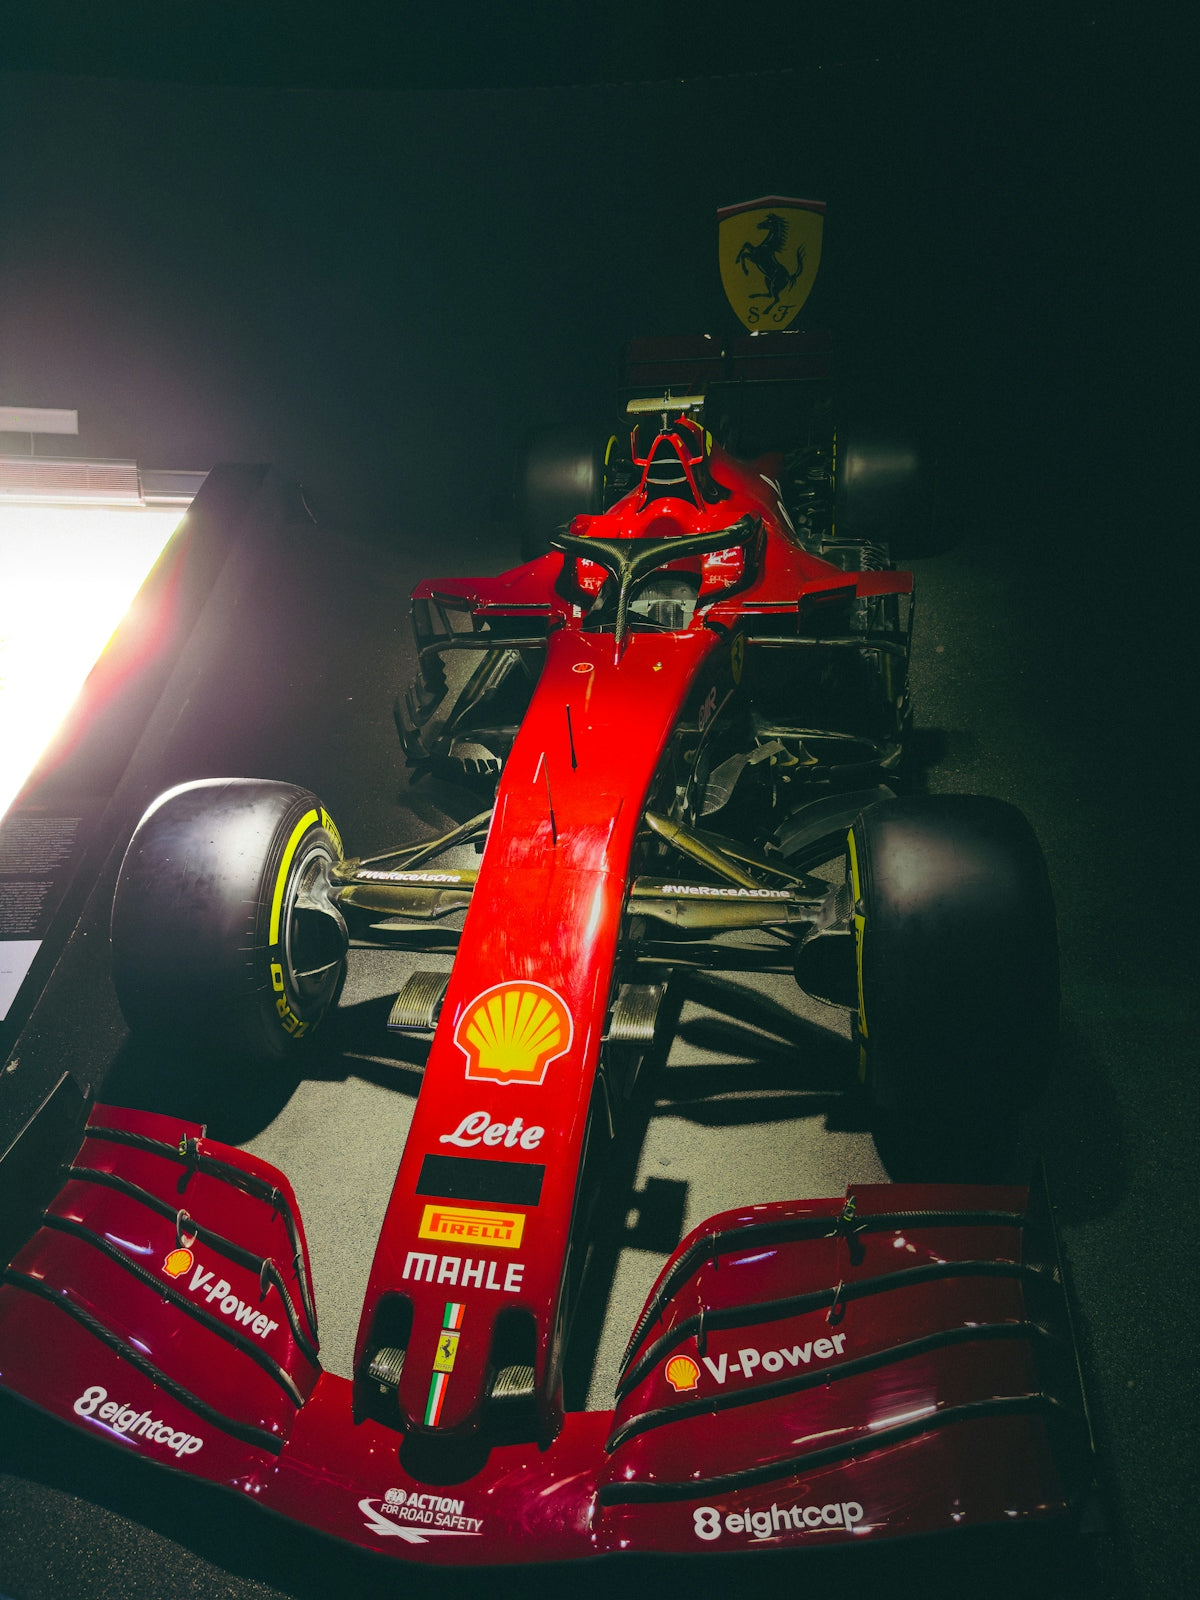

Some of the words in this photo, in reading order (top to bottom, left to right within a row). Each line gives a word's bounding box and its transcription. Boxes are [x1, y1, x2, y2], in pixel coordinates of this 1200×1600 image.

[748, 306, 760, 324] S
[356, 870, 461, 883] #WeRaceAsOne
[662, 885, 791, 898] #WeRaceAsOne
[438, 1110, 545, 1150] Lete
[429, 1213, 516, 1241] PIRELLI
[402, 1251, 525, 1293] MAHLE
[188, 1264, 279, 1339] V-Power
[702, 1333, 847, 1385] V-Power
[99, 1401, 203, 1458] eightcap
[380, 1503, 399, 1515] FOR
[398, 1507, 434, 1524] ROAD
[434, 1513, 484, 1532] SAFETY
[406, 1492, 465, 1515] ACTION
[725, 1501, 864, 1539] eightcap
